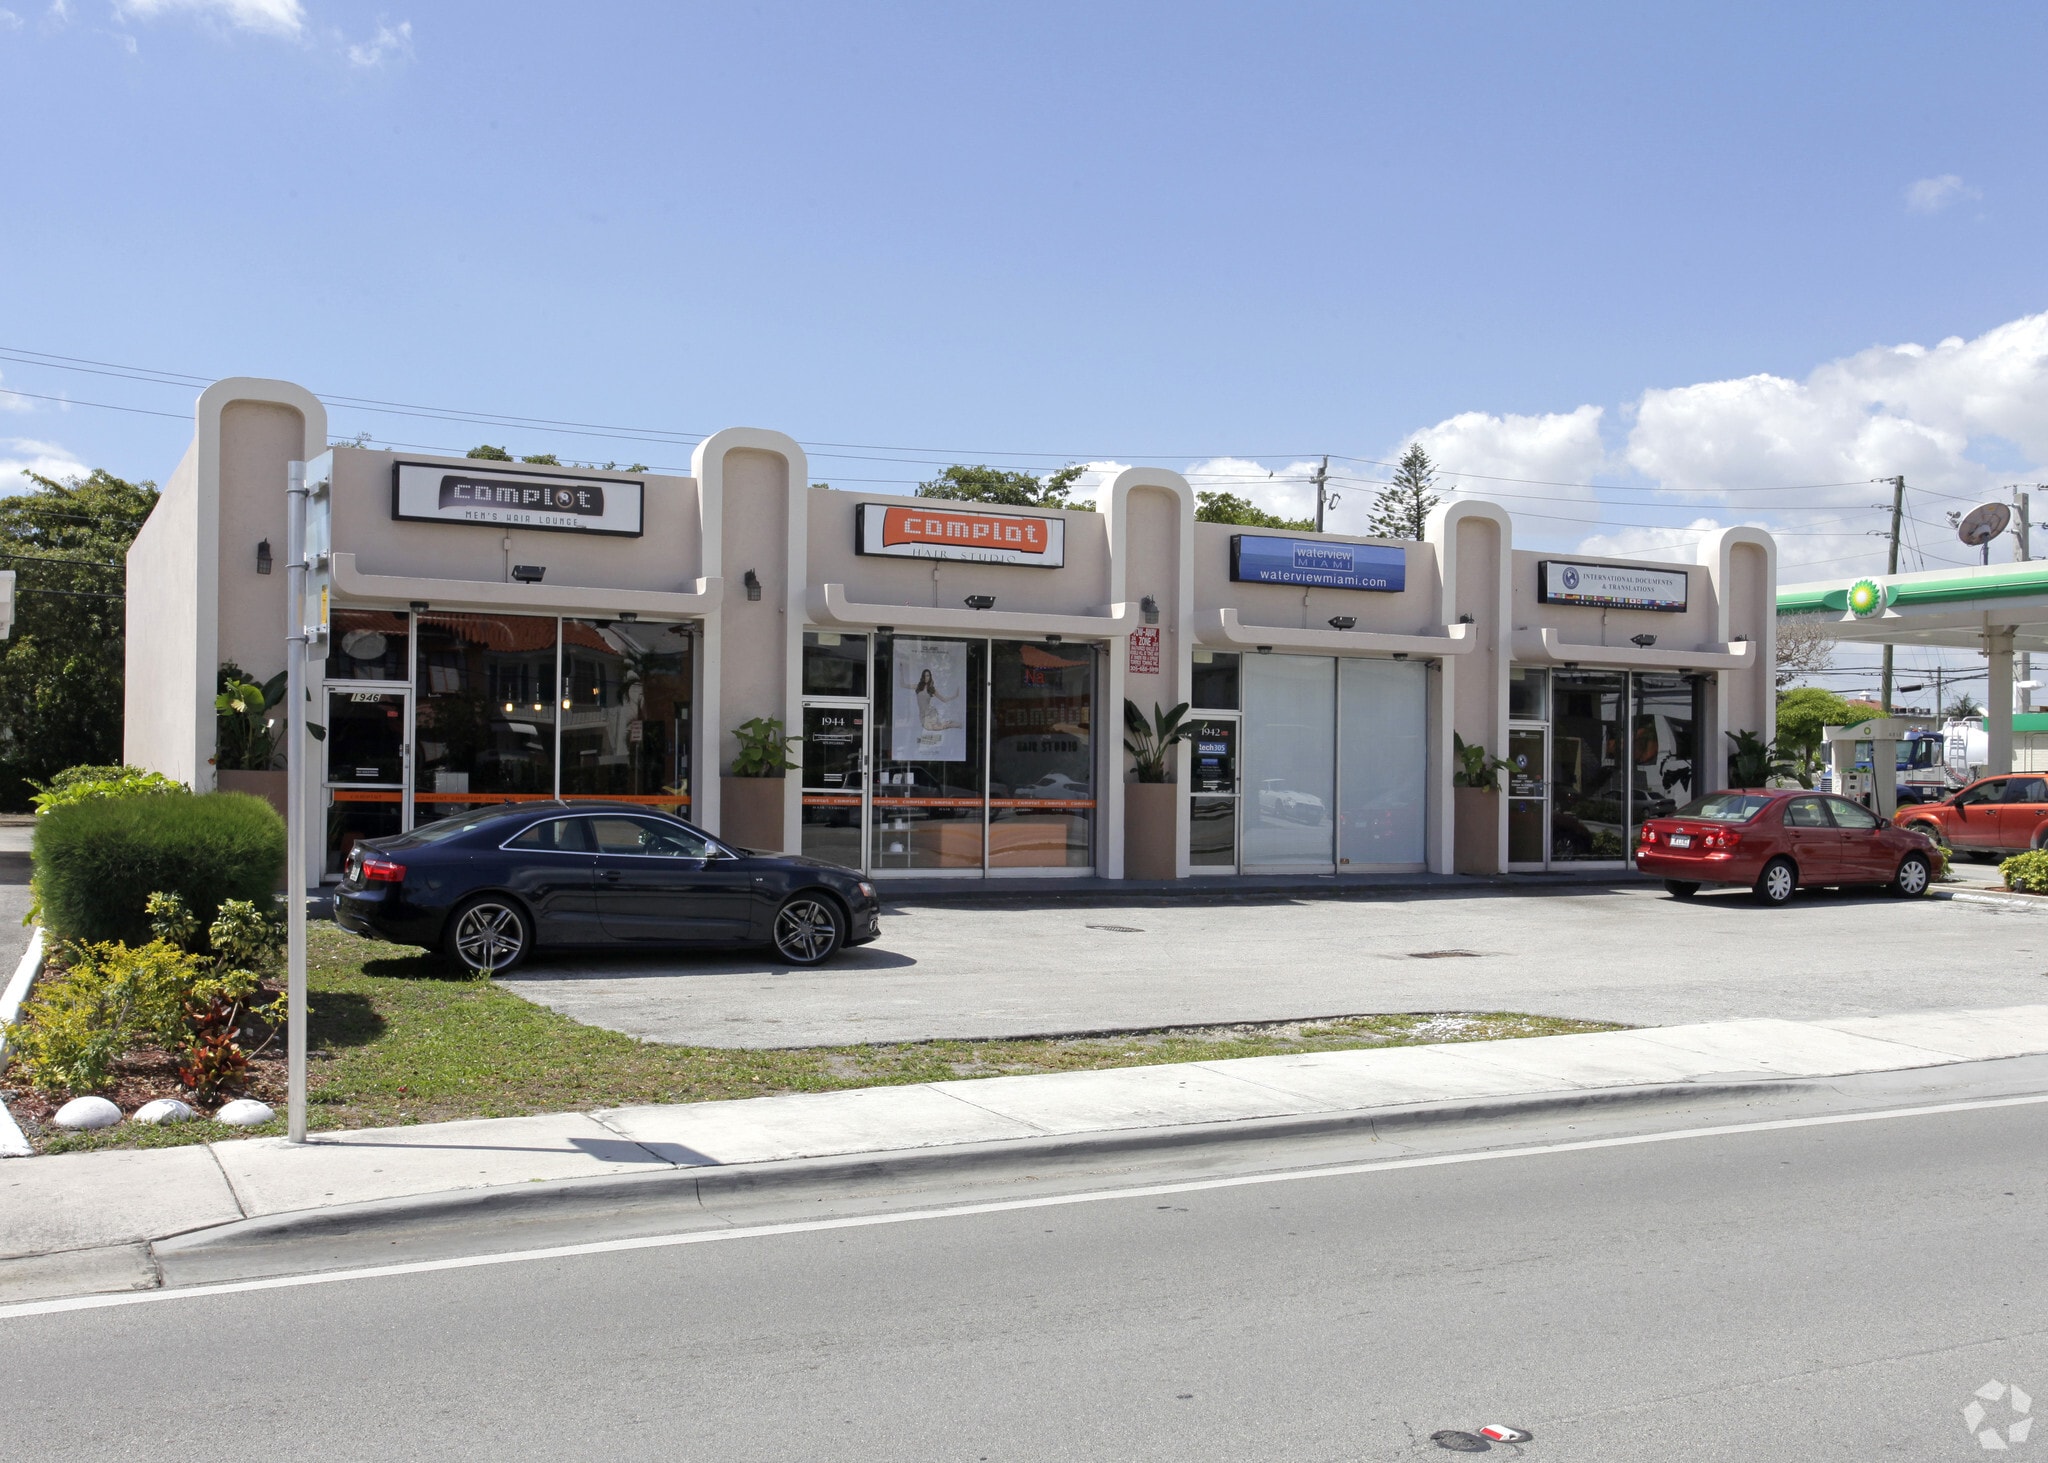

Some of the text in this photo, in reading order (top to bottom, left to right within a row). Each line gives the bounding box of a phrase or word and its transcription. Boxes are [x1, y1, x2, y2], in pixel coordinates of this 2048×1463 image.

[465, 510, 578, 527] MEN'S HAIR LOUNGE
[904, 518, 1038, 542] complot
[912, 548, 1016, 563] HAIR STUDIO
[1297, 548, 1350, 560] waterview
[1298, 558, 1350, 569] MIAMI
[1260, 570, 1387, 587] waterviewmiami.com
[1583, 574, 1673, 586] INTERNATIONAL DOCUMENTS
[1609, 584, 1654, 592] TRANSLATIONS
[1138, 636, 1152, 646] ZONE
[354, 693, 380, 702] 1946
[822, 717, 845, 726] 1944
[1202, 728, 1220, 736] 1942
[1016, 741, 1078, 752] HAIR STUDIO
[1199, 744, 1226, 752] tech305
